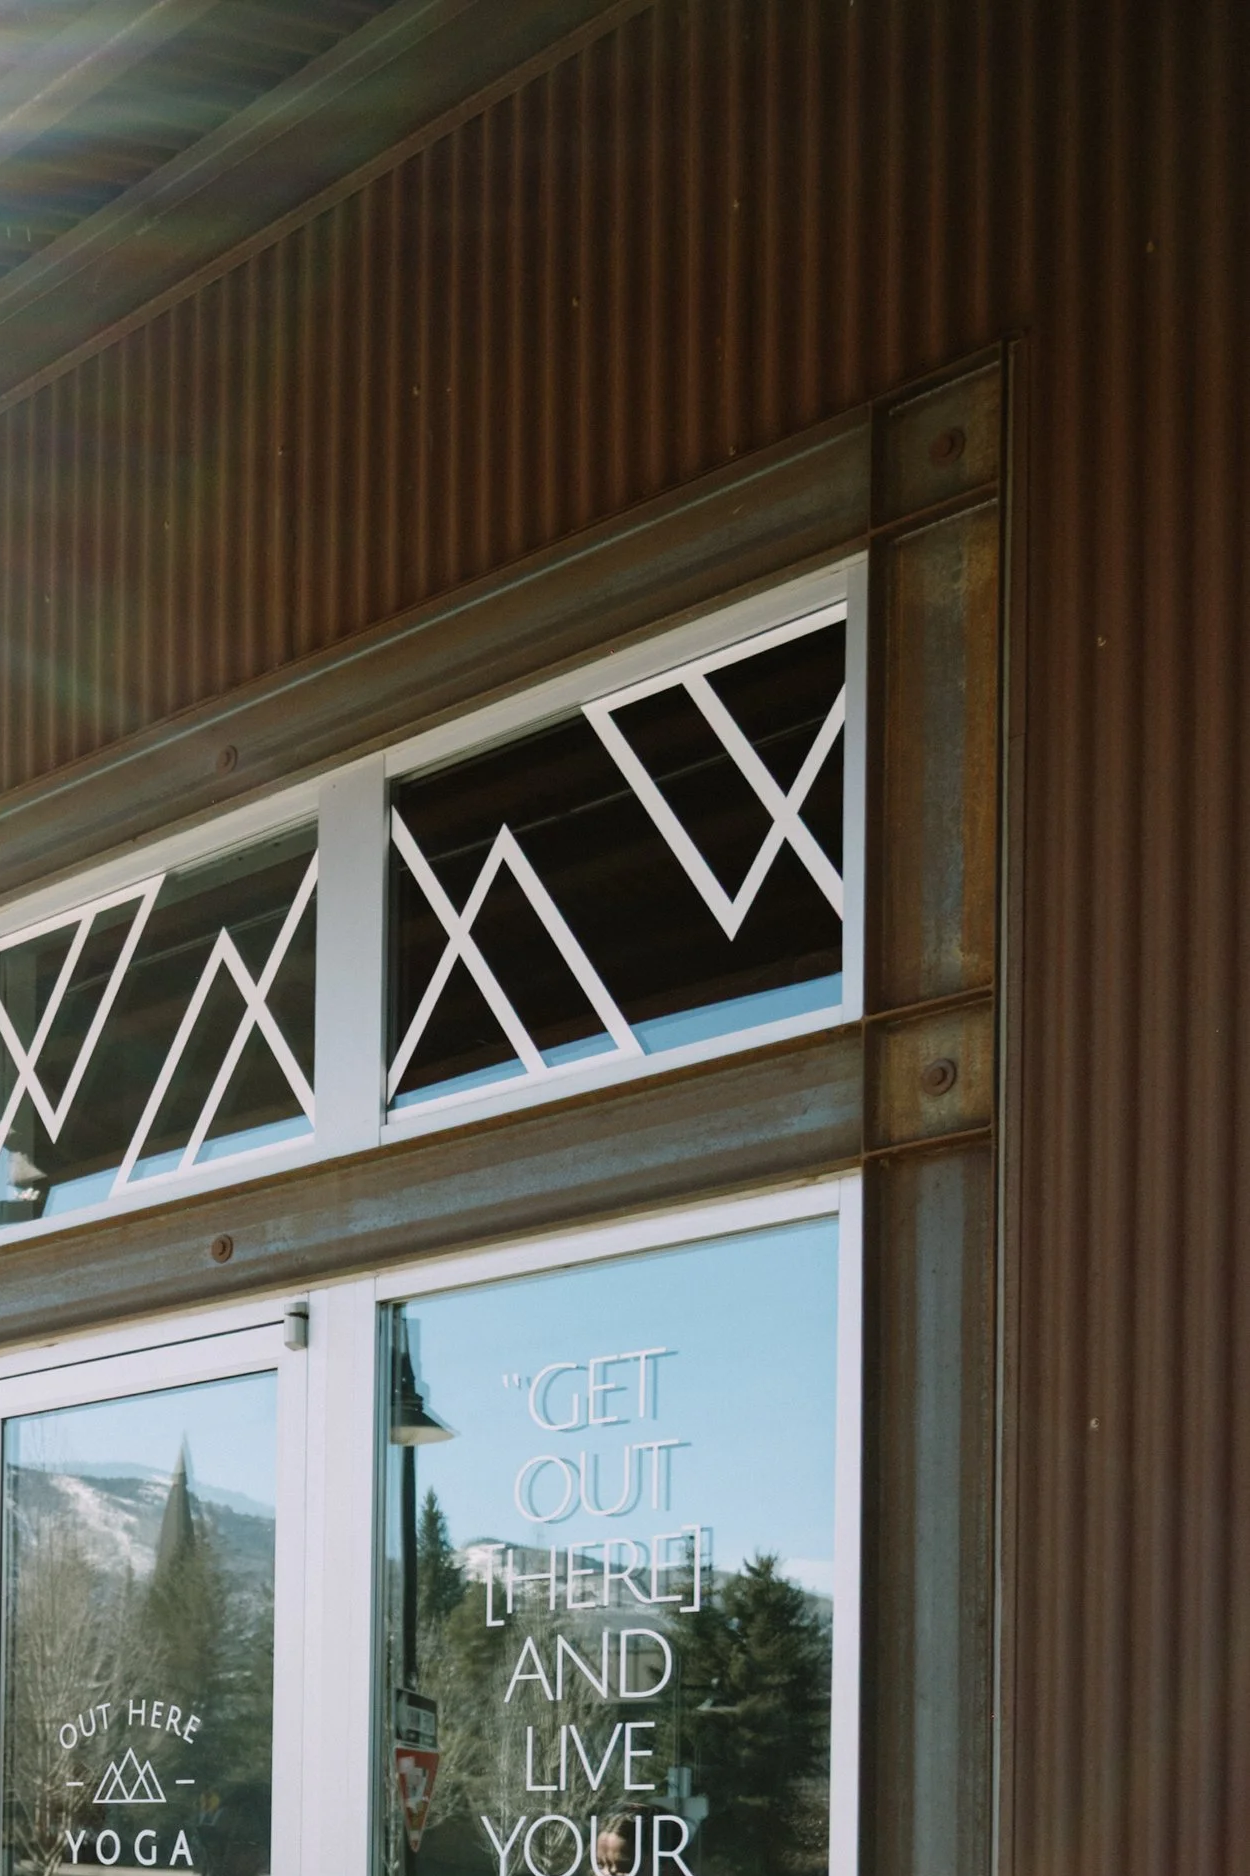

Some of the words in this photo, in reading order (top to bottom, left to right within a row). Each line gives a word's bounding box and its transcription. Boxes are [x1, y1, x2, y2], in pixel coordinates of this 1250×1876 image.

[514, 1439, 679, 1523] OUT
[486, 1525, 701, 1627] [HERE]
[505, 1628, 673, 1702] AND
[59, 1703, 112, 1749] OUT
[128, 1699, 201, 1745] HERE
[526, 1721, 656, 1791] LIVE
[65, 1829, 193, 1866] YOGA
